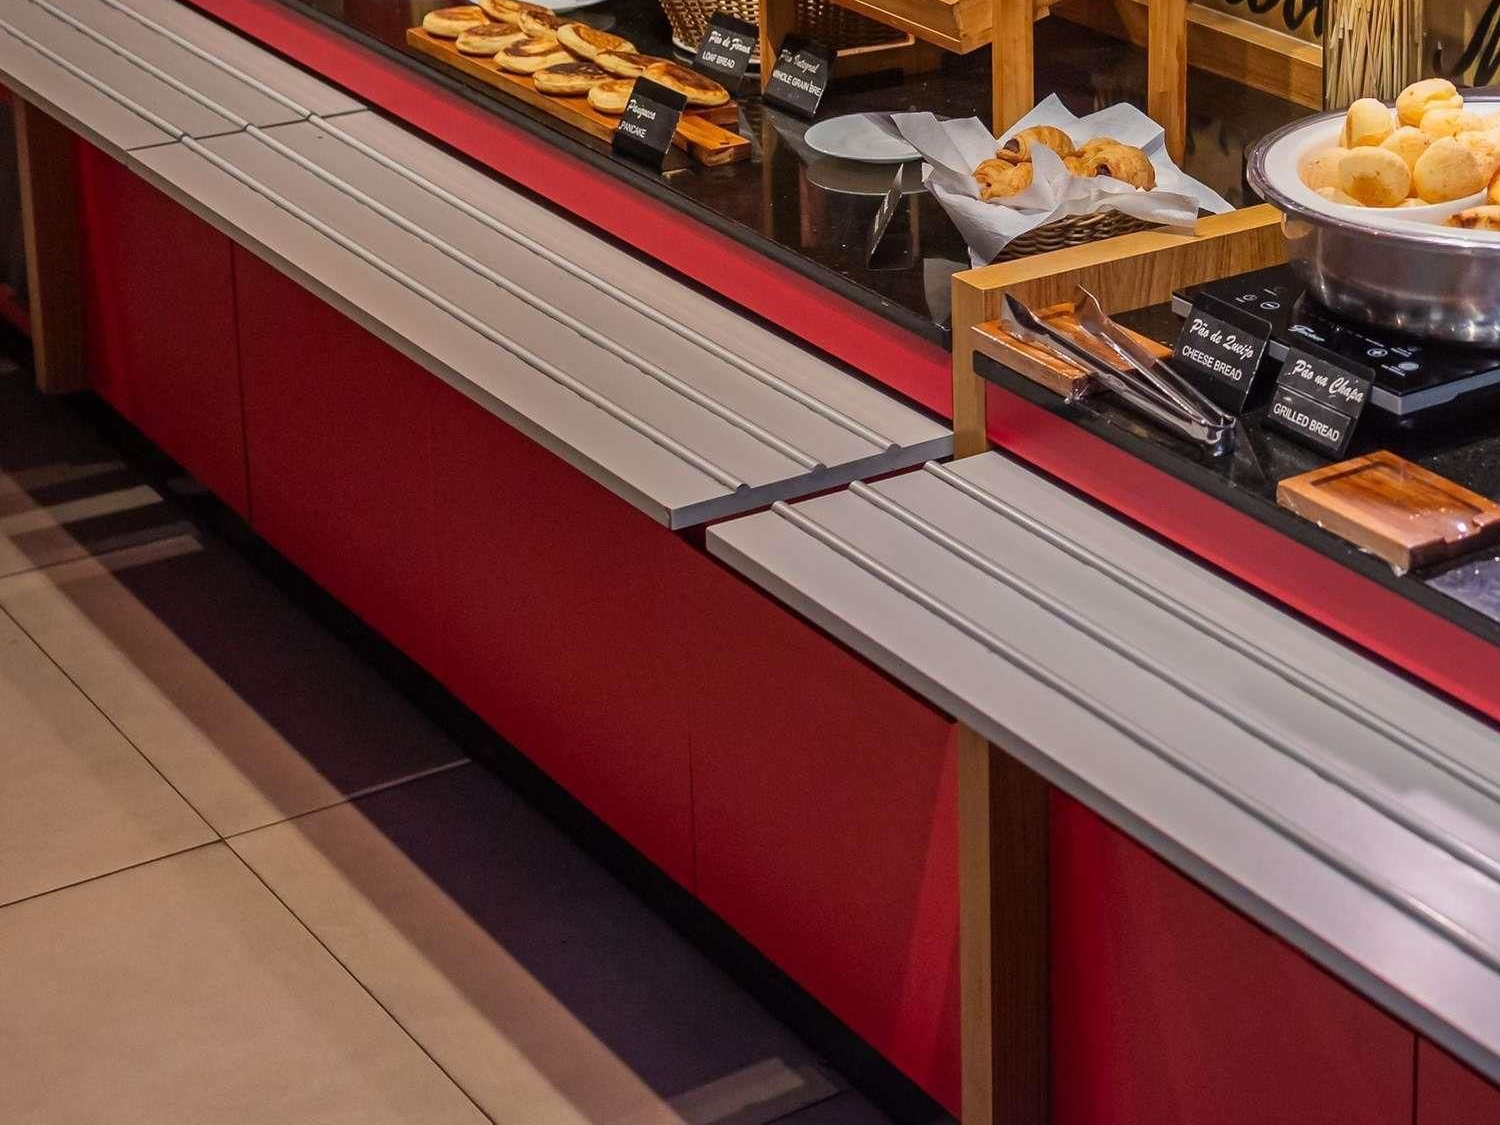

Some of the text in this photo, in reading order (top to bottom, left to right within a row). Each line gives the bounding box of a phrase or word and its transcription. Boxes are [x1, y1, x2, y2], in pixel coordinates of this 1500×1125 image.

[702, 51, 736, 69] LOAF BREAD
[791, 77, 810, 92] GRAIN
[619, 120, 648, 139] PANCAKE
[1190, 318, 1255, 361] Pão de Queijo
[1182, 345, 1242, 382] CHEESE BREAD
[1292, 359, 1365, 404] Pão na Chapa
[1273, 403, 1341, 443] GRILLED BREAD
